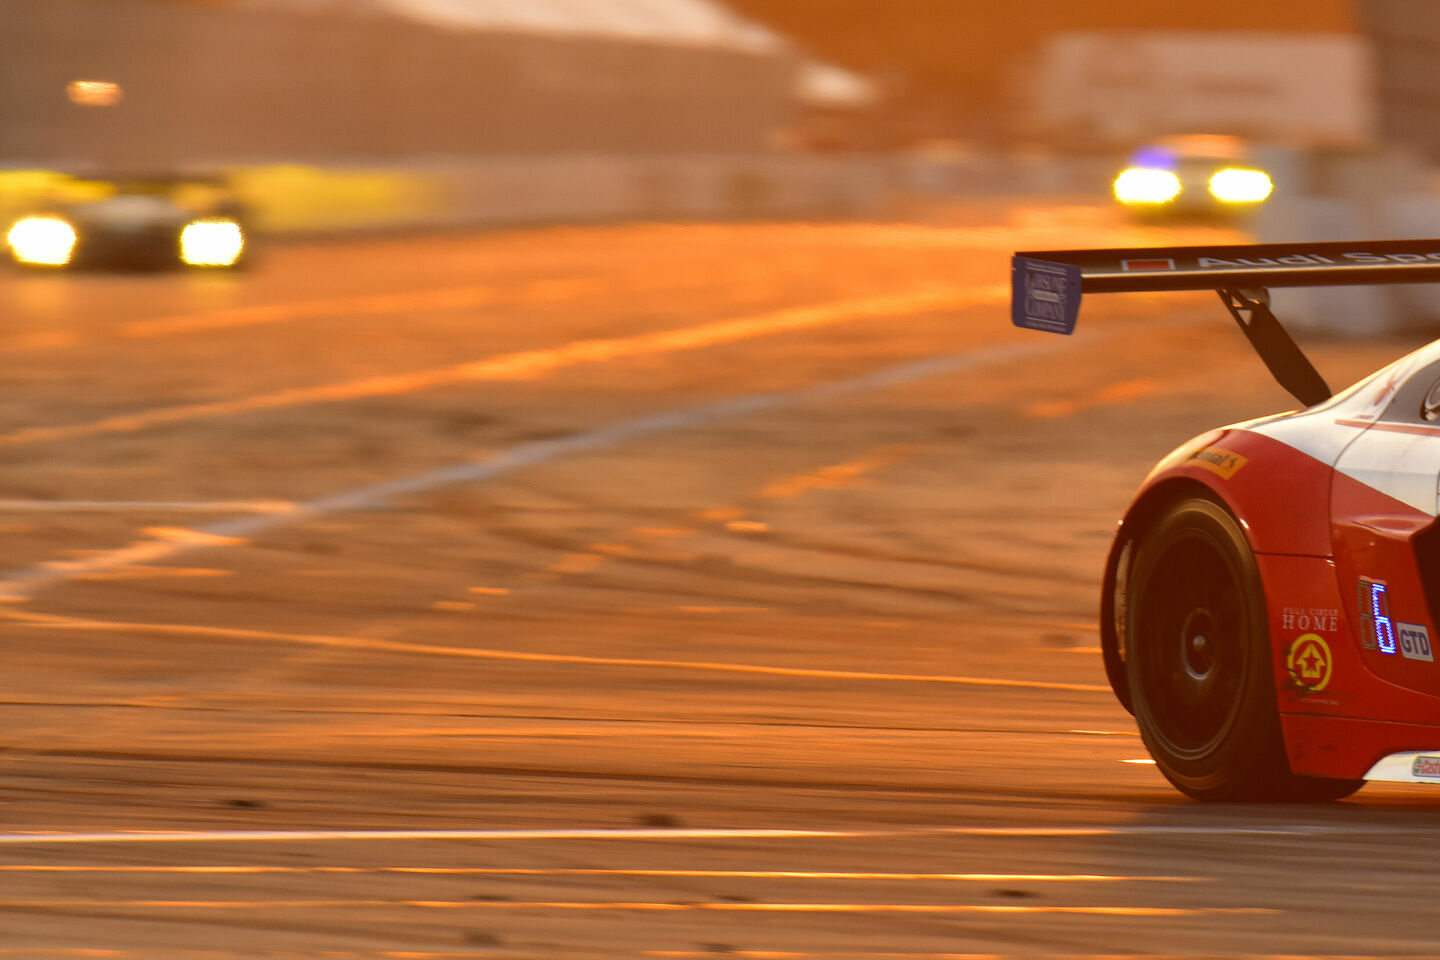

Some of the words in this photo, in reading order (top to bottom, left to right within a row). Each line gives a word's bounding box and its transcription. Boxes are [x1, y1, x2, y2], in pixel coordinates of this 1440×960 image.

[1199, 253, 1336, 269] Audi
[1282, 614, 1338, 631] HOME
[1399, 628, 1431, 656] GTD
